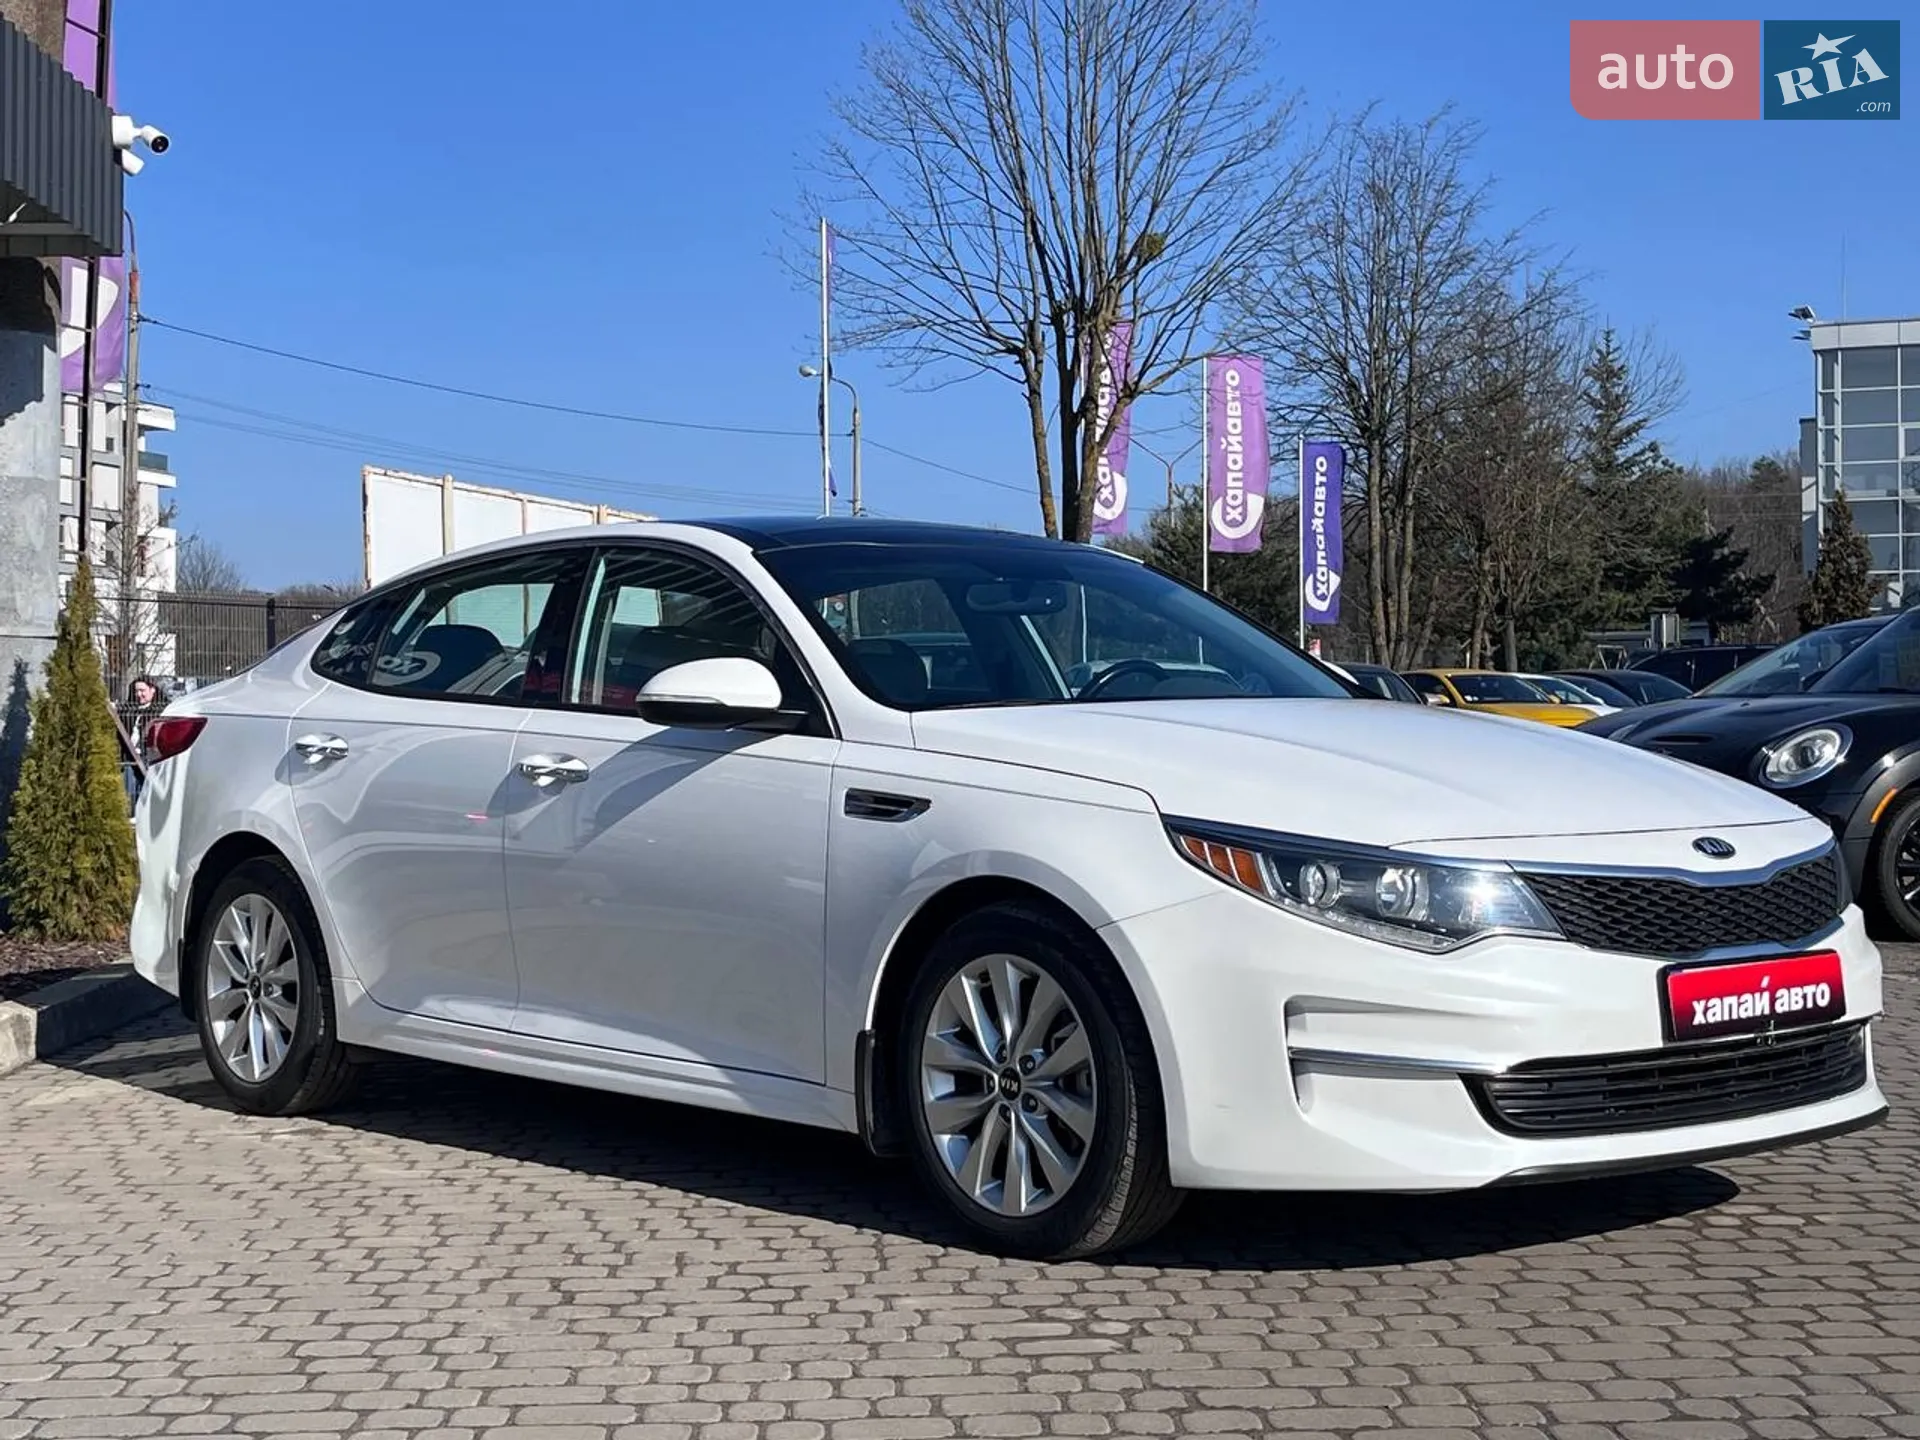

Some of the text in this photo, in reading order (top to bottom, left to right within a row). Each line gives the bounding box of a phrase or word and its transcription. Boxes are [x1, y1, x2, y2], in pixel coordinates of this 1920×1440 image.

[1220, 368, 1244, 523] хапайавто
[1311, 455, 1329, 597] хапайавто
[1774, 982, 1832, 1015] авто
